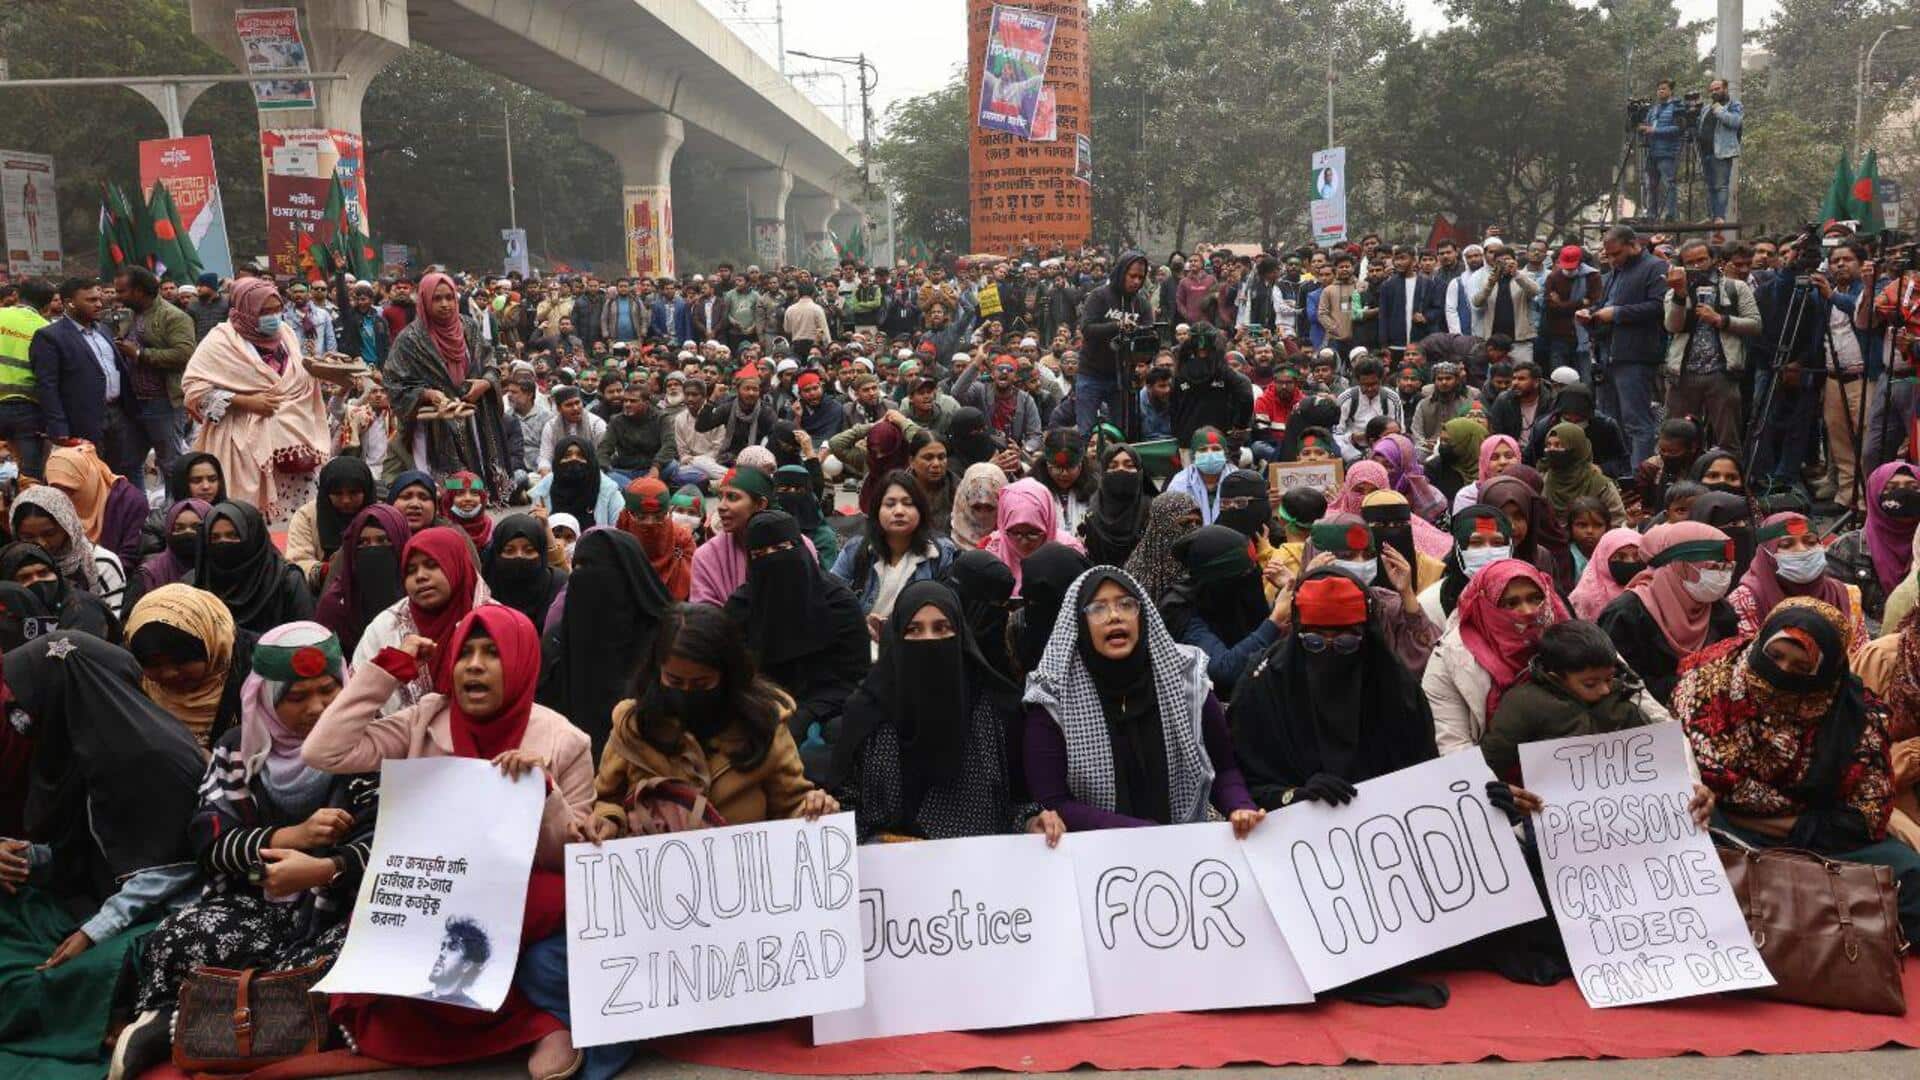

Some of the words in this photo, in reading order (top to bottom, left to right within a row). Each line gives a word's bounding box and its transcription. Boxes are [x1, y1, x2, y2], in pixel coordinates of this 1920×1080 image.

[1553, 733, 1658, 792] THE
[1541, 792, 1697, 859] PERSON
[447, 857, 468, 875] হাদি
[576, 825, 853, 940] INQUILAB
[1556, 863, 1637, 920] CAN
[1644, 850, 1720, 901] DIE
[375, 888, 403, 907] বিচার
[405, 894, 441, 915] কতটুকু
[859, 888, 1032, 962] Justice
[1096, 858, 1246, 950] FOR
[600, 929, 847, 1016] ZINDABAD
